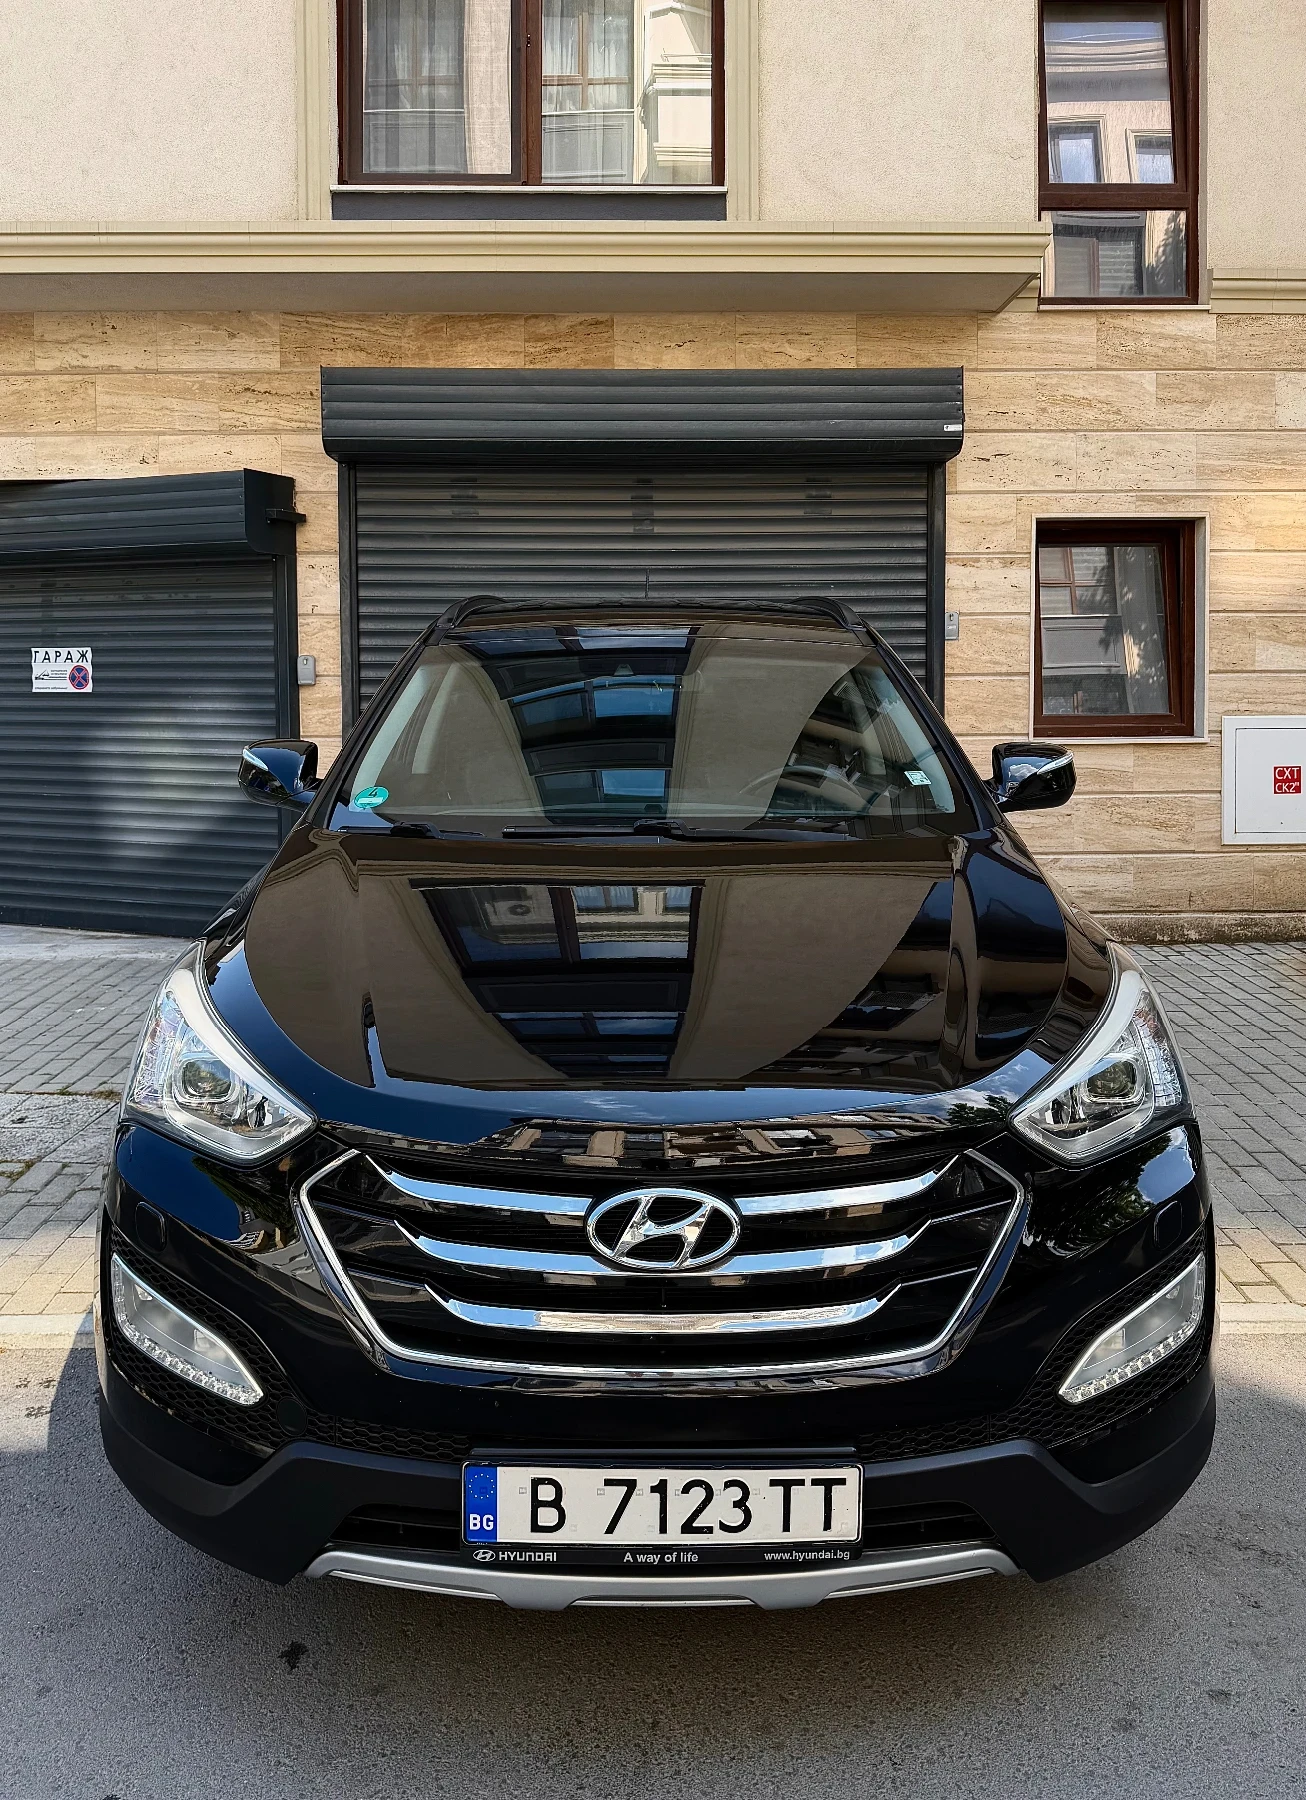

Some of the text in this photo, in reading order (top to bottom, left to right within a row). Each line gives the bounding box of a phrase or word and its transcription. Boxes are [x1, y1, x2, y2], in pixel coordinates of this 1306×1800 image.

[33, 650, 89, 663] ГАРАЖ
[368, 787, 378, 797] 4
[530, 1477, 847, 1534] B 7123 TT
[469, 1514, 494, 1531] BG
[499, 1551, 557, 1562] HYUNDAI
[623, 1552, 699, 1564] A way of life
[764, 1550, 850, 1562] www.hyundai.bg
